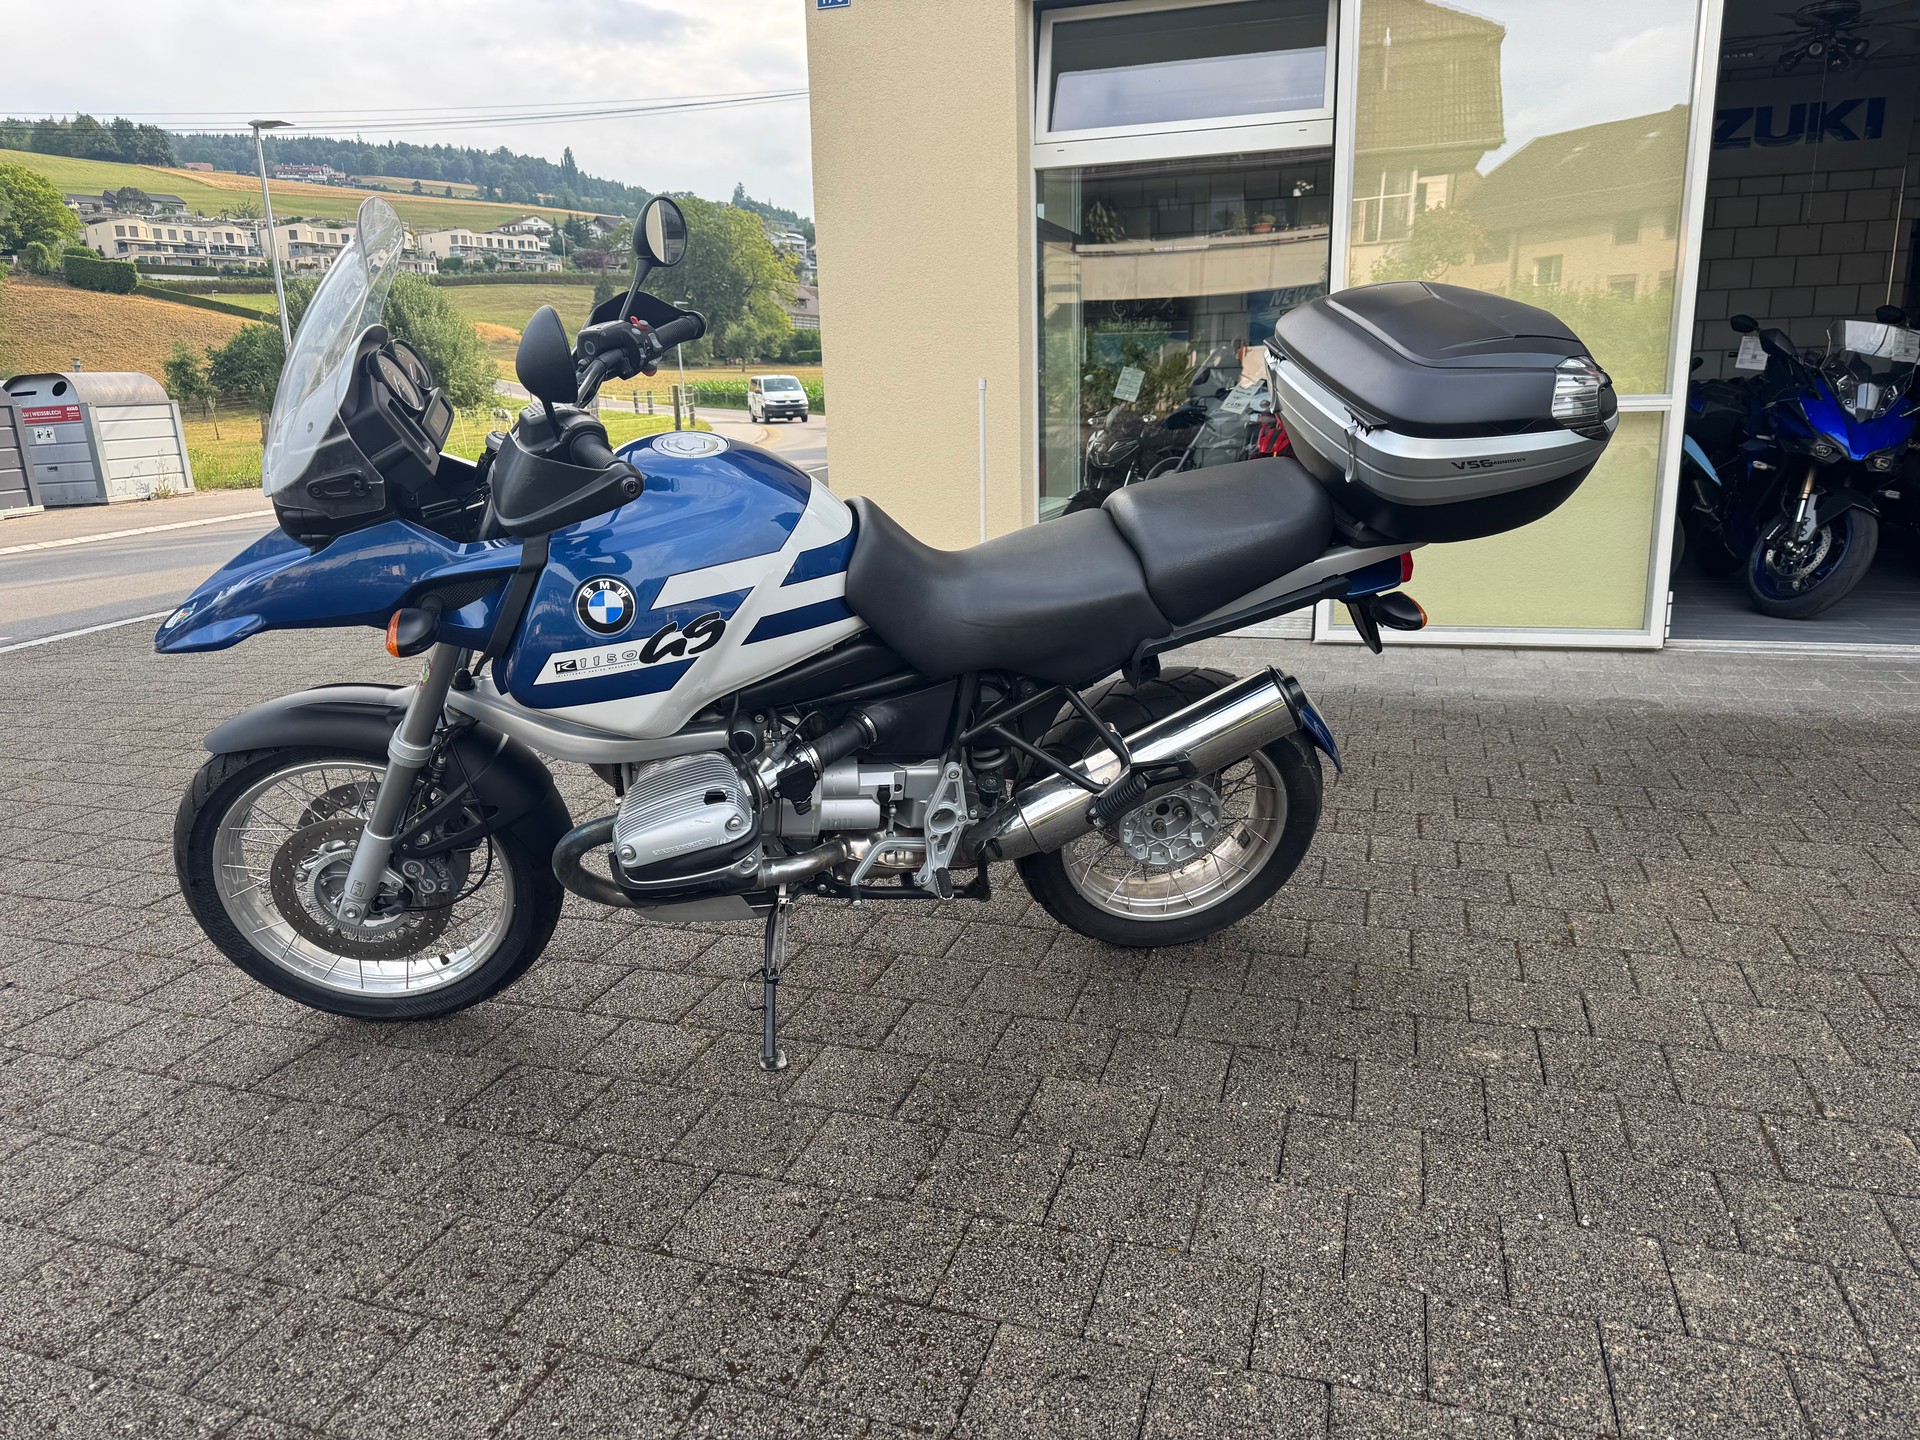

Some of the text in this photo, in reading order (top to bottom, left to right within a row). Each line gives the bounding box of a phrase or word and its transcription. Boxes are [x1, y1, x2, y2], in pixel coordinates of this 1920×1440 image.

[1269, 286, 1311, 306] NEW
[1451, 459, 1494, 470] V56
[583, 580, 629, 599] BMW
[639, 611, 726, 664] GS
